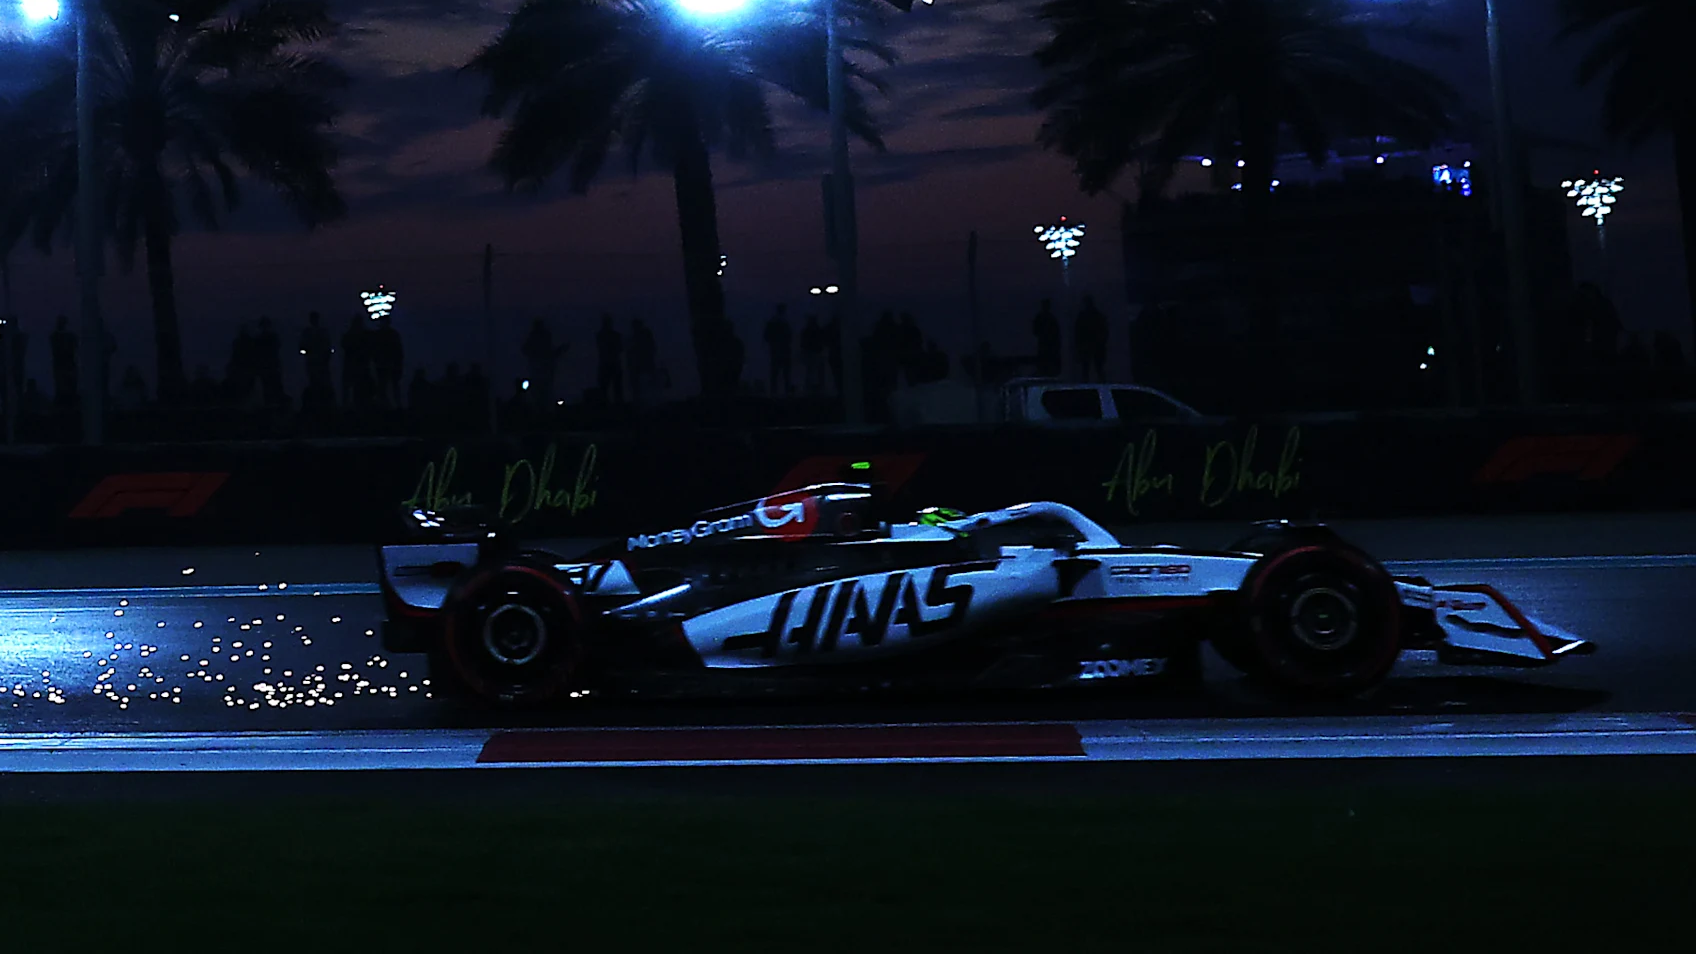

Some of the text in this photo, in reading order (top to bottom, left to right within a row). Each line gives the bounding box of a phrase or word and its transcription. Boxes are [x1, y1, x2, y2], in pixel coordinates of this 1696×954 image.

[498, 443, 600, 524] Dhabi
[1101, 425, 1302, 517] Abu Dhabi
[626, 513, 754, 552] MoneyGram
[722, 560, 1000, 659] HAAS
